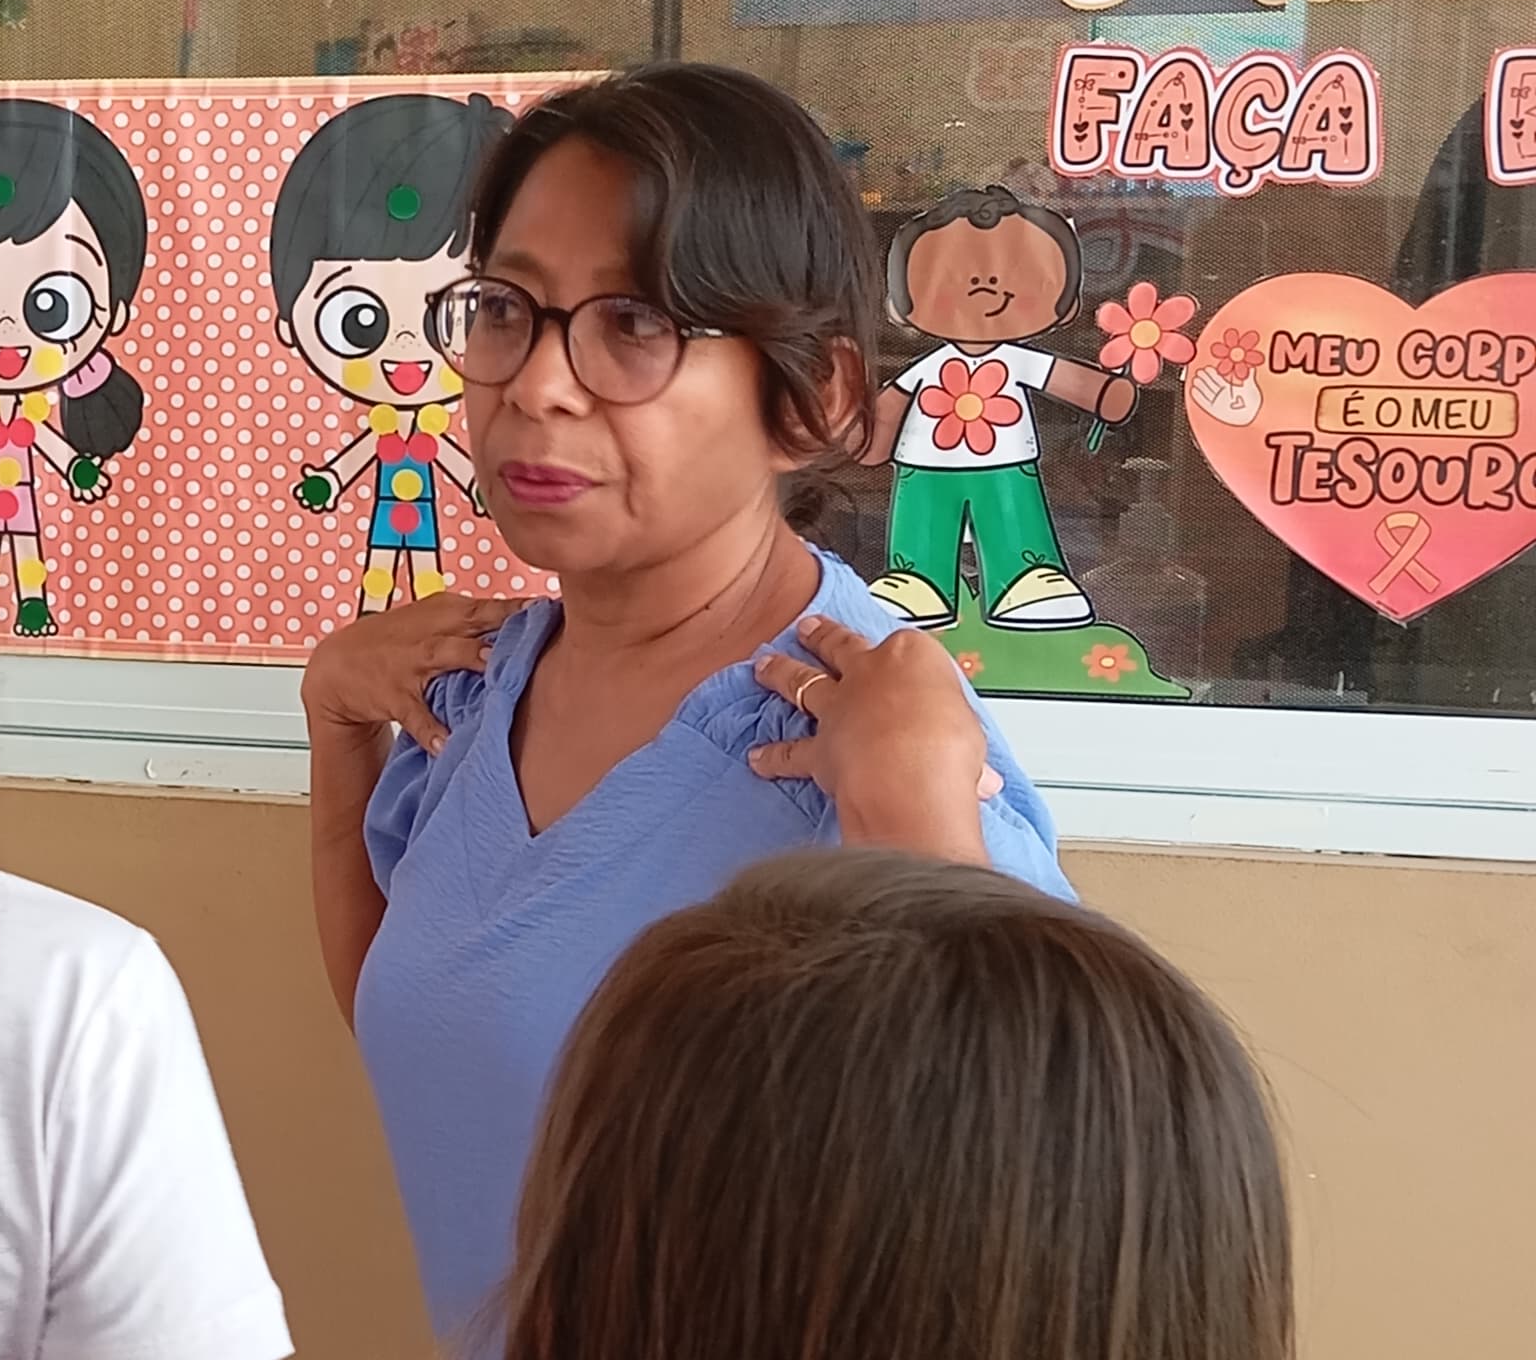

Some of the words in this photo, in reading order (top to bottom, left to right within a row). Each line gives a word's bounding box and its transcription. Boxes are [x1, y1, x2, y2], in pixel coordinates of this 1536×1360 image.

[1058, 53, 1371, 188] FAÇA
[1269, 329, 1380, 377] MEU
[1397, 328, 1536, 387] CORP
[1342, 389, 1365, 427] É
[1375, 397, 1402, 428] O
[1411, 397, 1493, 430] MEU
